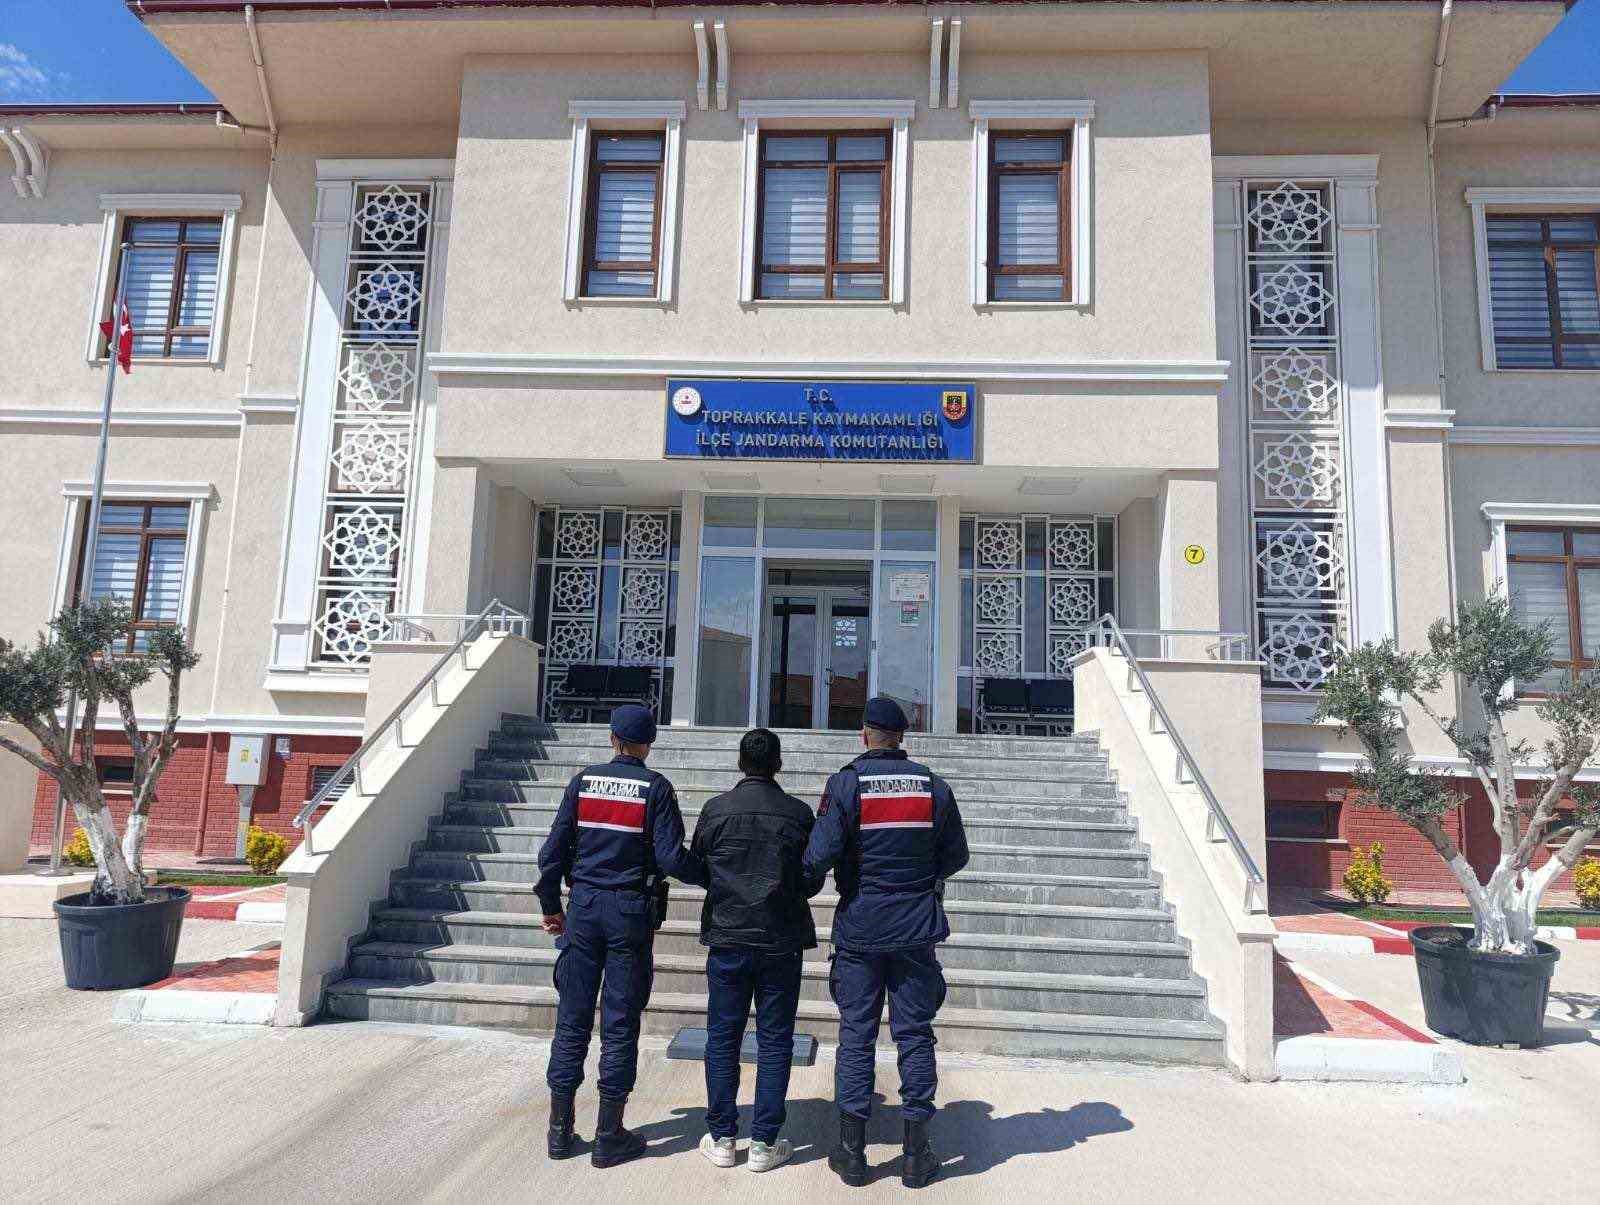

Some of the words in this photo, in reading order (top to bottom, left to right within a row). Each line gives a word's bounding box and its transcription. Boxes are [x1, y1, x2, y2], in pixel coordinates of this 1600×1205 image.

[803, 388, 833, 402] T.C.
[702, 410, 807, 424] TOPRAKKALE
[813, 411, 938, 426] KAYMAKAMLIĞI
[695, 429, 731, 447] İLÇE
[735, 433, 825, 447] JANDARMA
[830, 434, 943, 449] KOMUTANLIĞI
[1190, 549, 1199, 560] 7
[585, 779, 640, 797] JANDARMA
[867, 779, 924, 793] JANDARMA
